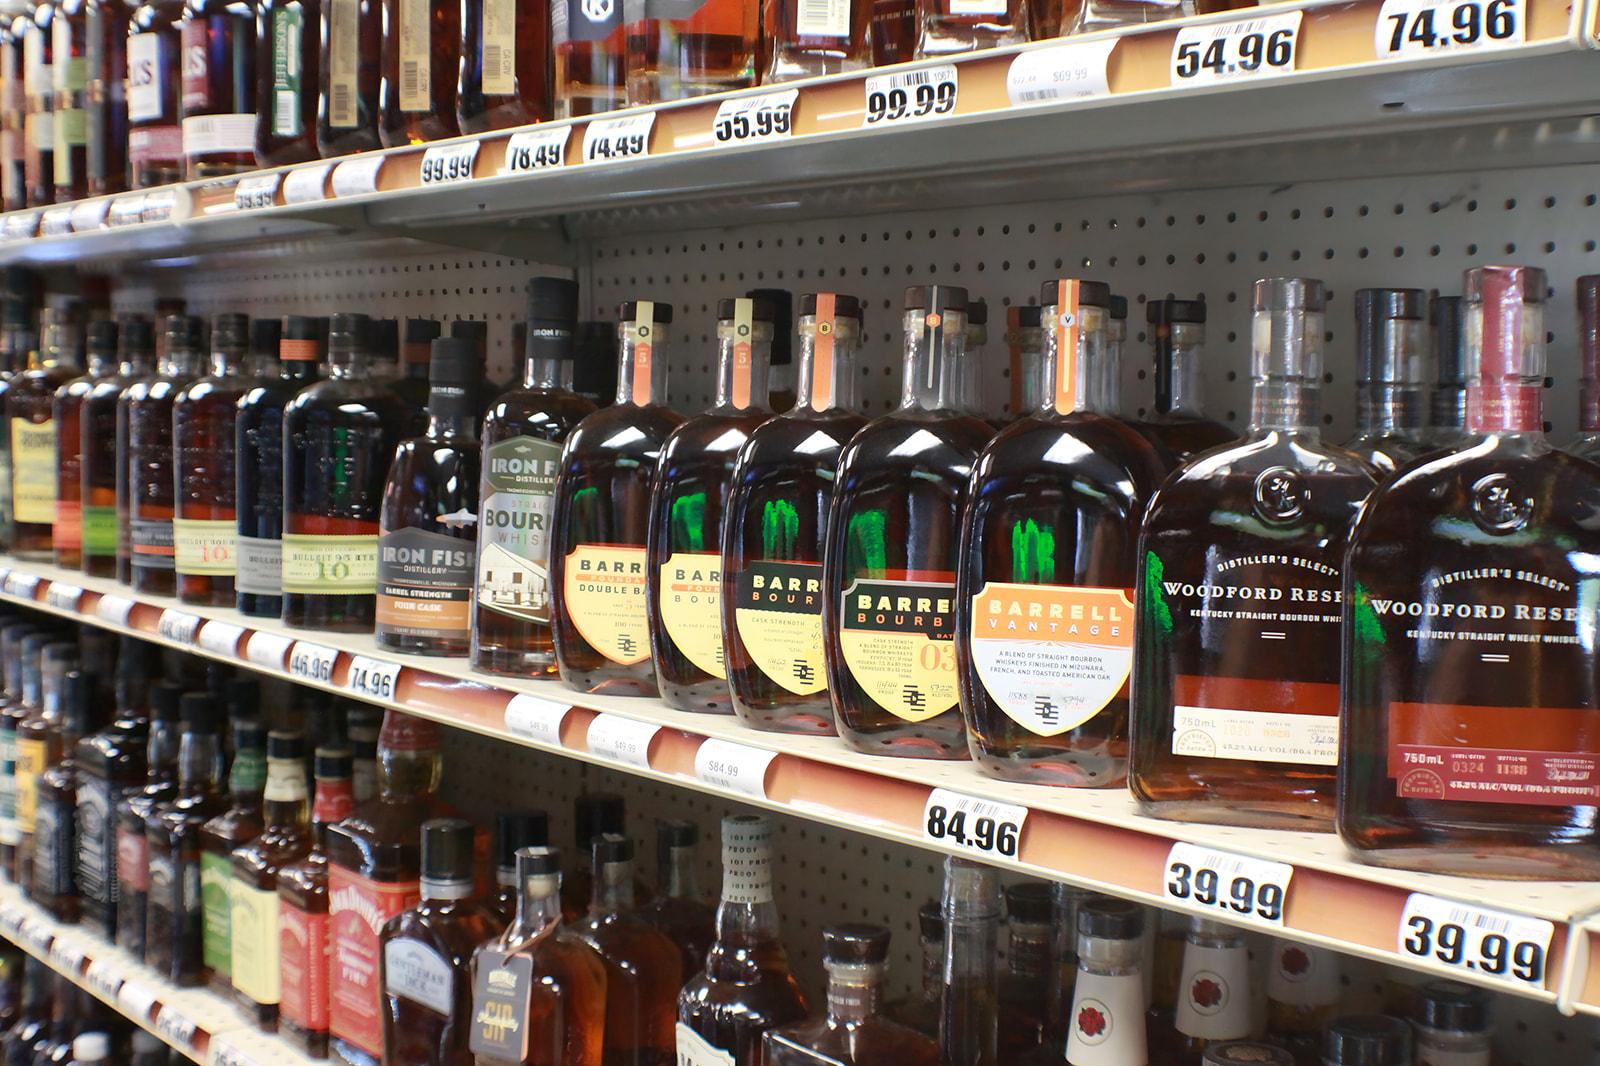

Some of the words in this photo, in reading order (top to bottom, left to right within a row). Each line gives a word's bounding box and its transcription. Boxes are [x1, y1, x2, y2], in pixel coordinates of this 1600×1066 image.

[1388, 0, 1515, 52] 74.96
[1176, 29, 1293, 78] 54.96
[867, 82, 878, 91] 221
[934, 70, 954, 81] 10671
[1053, 67, 1087, 82] $69.99
[867, 81, 956, 123] 99.99
[716, 103, 790, 141] 55.99
[589, 135, 644, 160] 74.49
[511, 143, 560, 171] 78.49
[422, 154, 471, 182] 99.99
[1065, 316, 1071, 324] V
[533, 328, 554, 337] IRON
[639, 352, 647, 363] 5
[739, 352, 746, 363] 5
[492, 458, 537, 474] IRON
[201, 545, 229, 562] 10
[293, 553, 331, 561] BULLEIT
[383, 547, 426, 564] IRON
[316, 561, 350, 580] 10
[403, 565, 447, 574] DISTILLERY
[581, 560, 641, 573] BARR
[1216, 555, 1288, 573] DISTILLER'S
[1292, 557, 1335, 577] SELECT
[676, 569, 720, 581] BAR
[1431, 568, 1512, 588] DISTILLER'S
[1516, 570, 1564, 592] SELECT
[580, 584, 627, 594] DOUBLE
[753, 575, 820, 593] BARR
[1163, 582, 1283, 600] WOODFORD
[410, 590, 453, 598] STRENGTH
[675, 595, 715, 604] BOU
[752, 592, 814, 604] BOUR
[417, 603, 443, 612] CASK
[858, 595, 950, 613] BARRE
[989, 599, 1121, 621] BARRELL
[1370, 599, 1506, 619] WOODFORD
[857, 613, 942, 627] BOURB
[1190, 609, 1233, 619] KENTUCKY
[1235, 611, 1277, 620] STRAIGHT
[1279, 613, 1320, 622] BOURBON
[989, 618, 1119, 636] VANTAGE
[1406, 630, 1456, 640] KENTUCKY
[1457, 632, 1506, 642] STRAIGHT
[1507, 633, 1542, 643] WHEAT
[920, 644, 955, 671] 03
[1037, 653, 1069, 661] STRAIGHT
[1070, 655, 1103, 663] BOURBON
[291, 654, 330, 681] 46.96
[990, 666, 1016, 674] FRENCH,
[1032, 670, 1060, 678] TOASTED
[1062, 672, 1096, 680] AMERICAN
[1029, 661, 1059, 669] FINISHED
[1069, 664, 1106, 672] MIZUNARA,
[352, 667, 391, 697] 74.96
[1181, 717, 1217, 727] 750mL
[614, 740, 636, 753] $49.99
[1248, 745, 1287, 753] ALC/VOL
[1404, 753, 1444, 765] 750mL
[1452, 761, 1484, 773] 0324
[709, 760, 738, 777] $84.99
[927, 805, 1018, 856] 84.96
[1168, 862, 1283, 920] 39.99
[1404, 915, 1543, 982] 39.99
